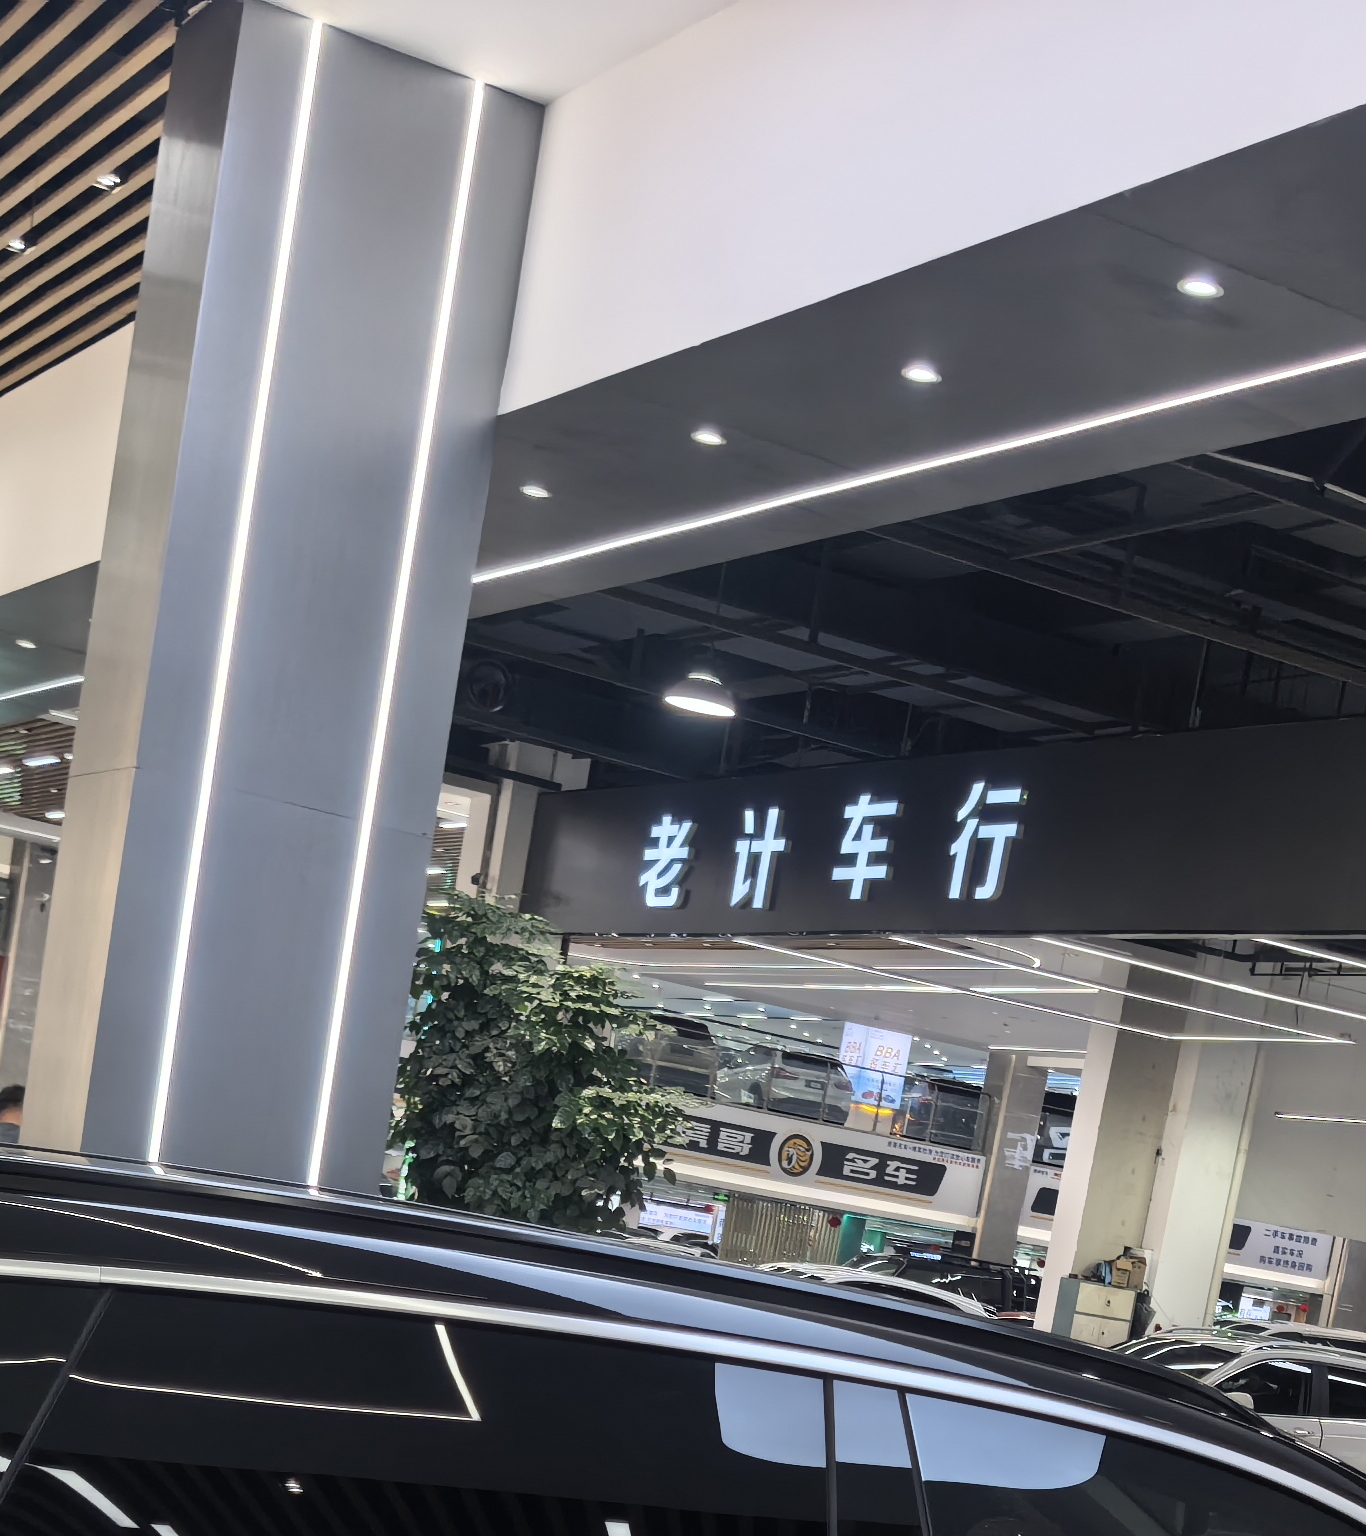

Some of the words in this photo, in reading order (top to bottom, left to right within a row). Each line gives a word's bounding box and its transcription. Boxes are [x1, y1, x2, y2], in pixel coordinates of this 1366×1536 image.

[638, 780, 1026, 909] 老计车行
[843, 1151, 918, 1186] 名车
